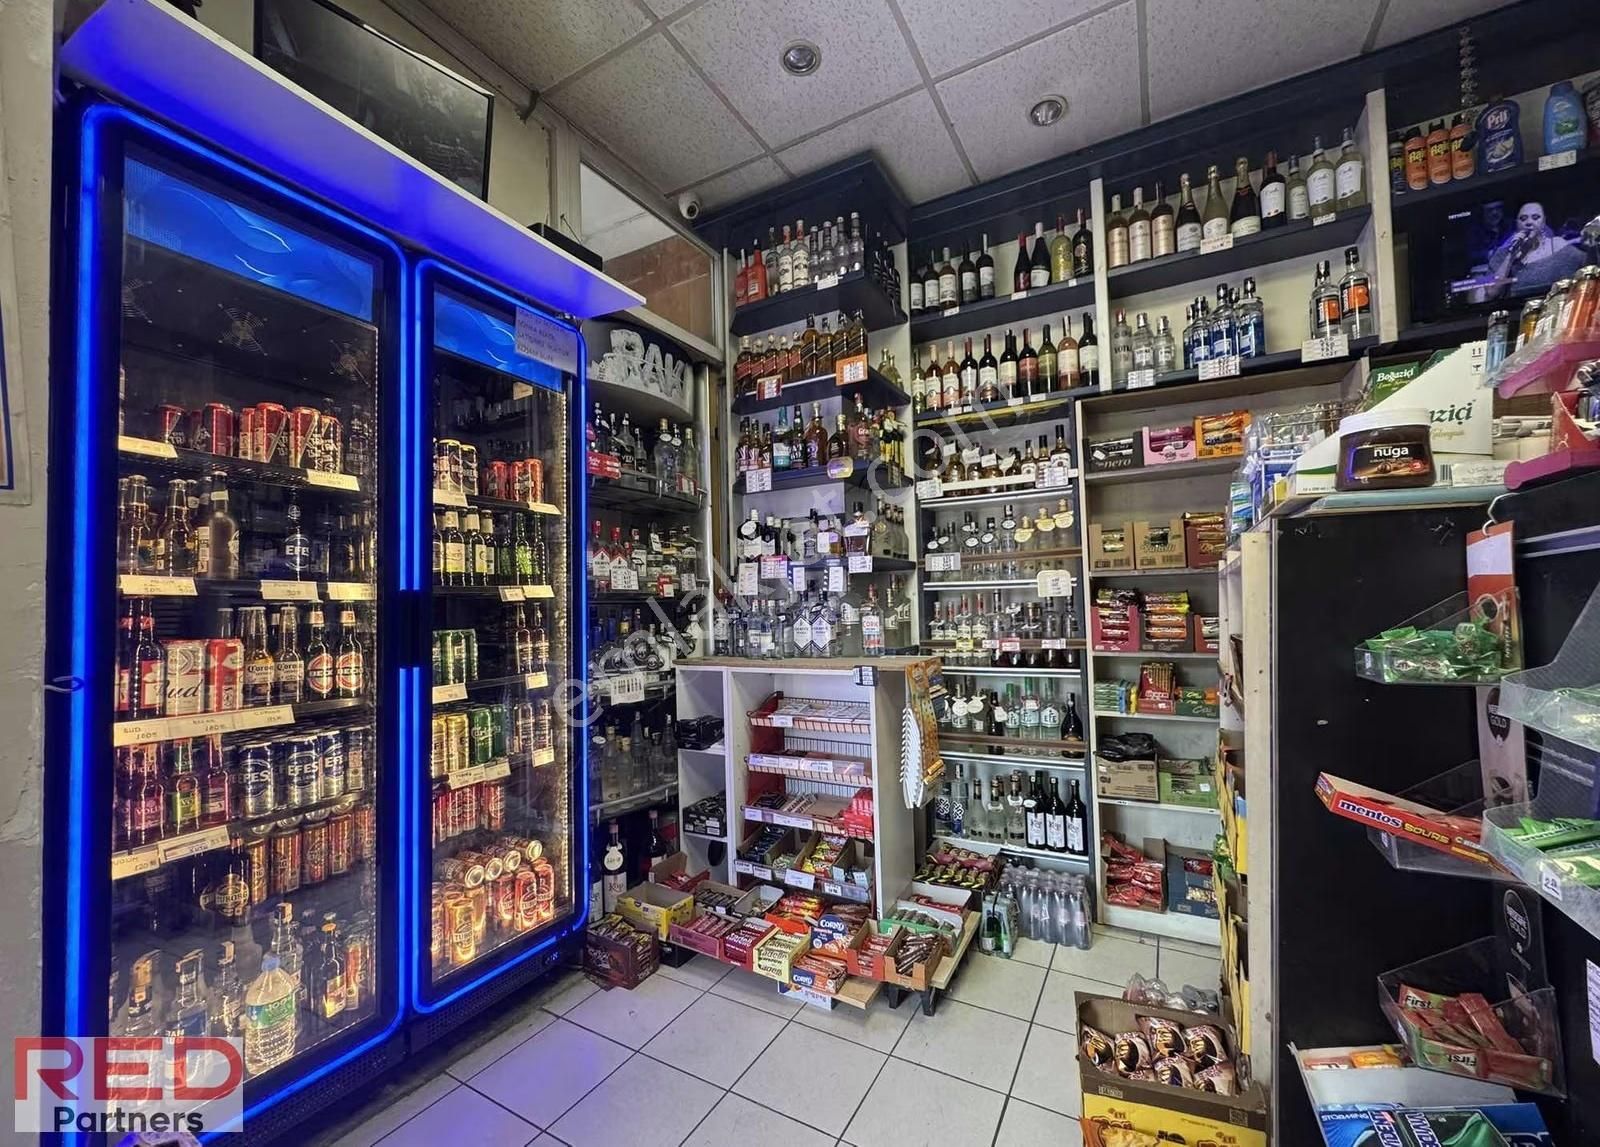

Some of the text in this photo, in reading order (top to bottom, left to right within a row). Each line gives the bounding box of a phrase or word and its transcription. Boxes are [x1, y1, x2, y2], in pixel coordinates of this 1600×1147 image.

[1374, 446, 1409, 458] nuga
[288, 761, 319, 776] EFES
[1338, 799, 1402, 829] mentos
[1404, 823, 1450, 845] SOURS
[1405, 995, 1432, 1009] First
